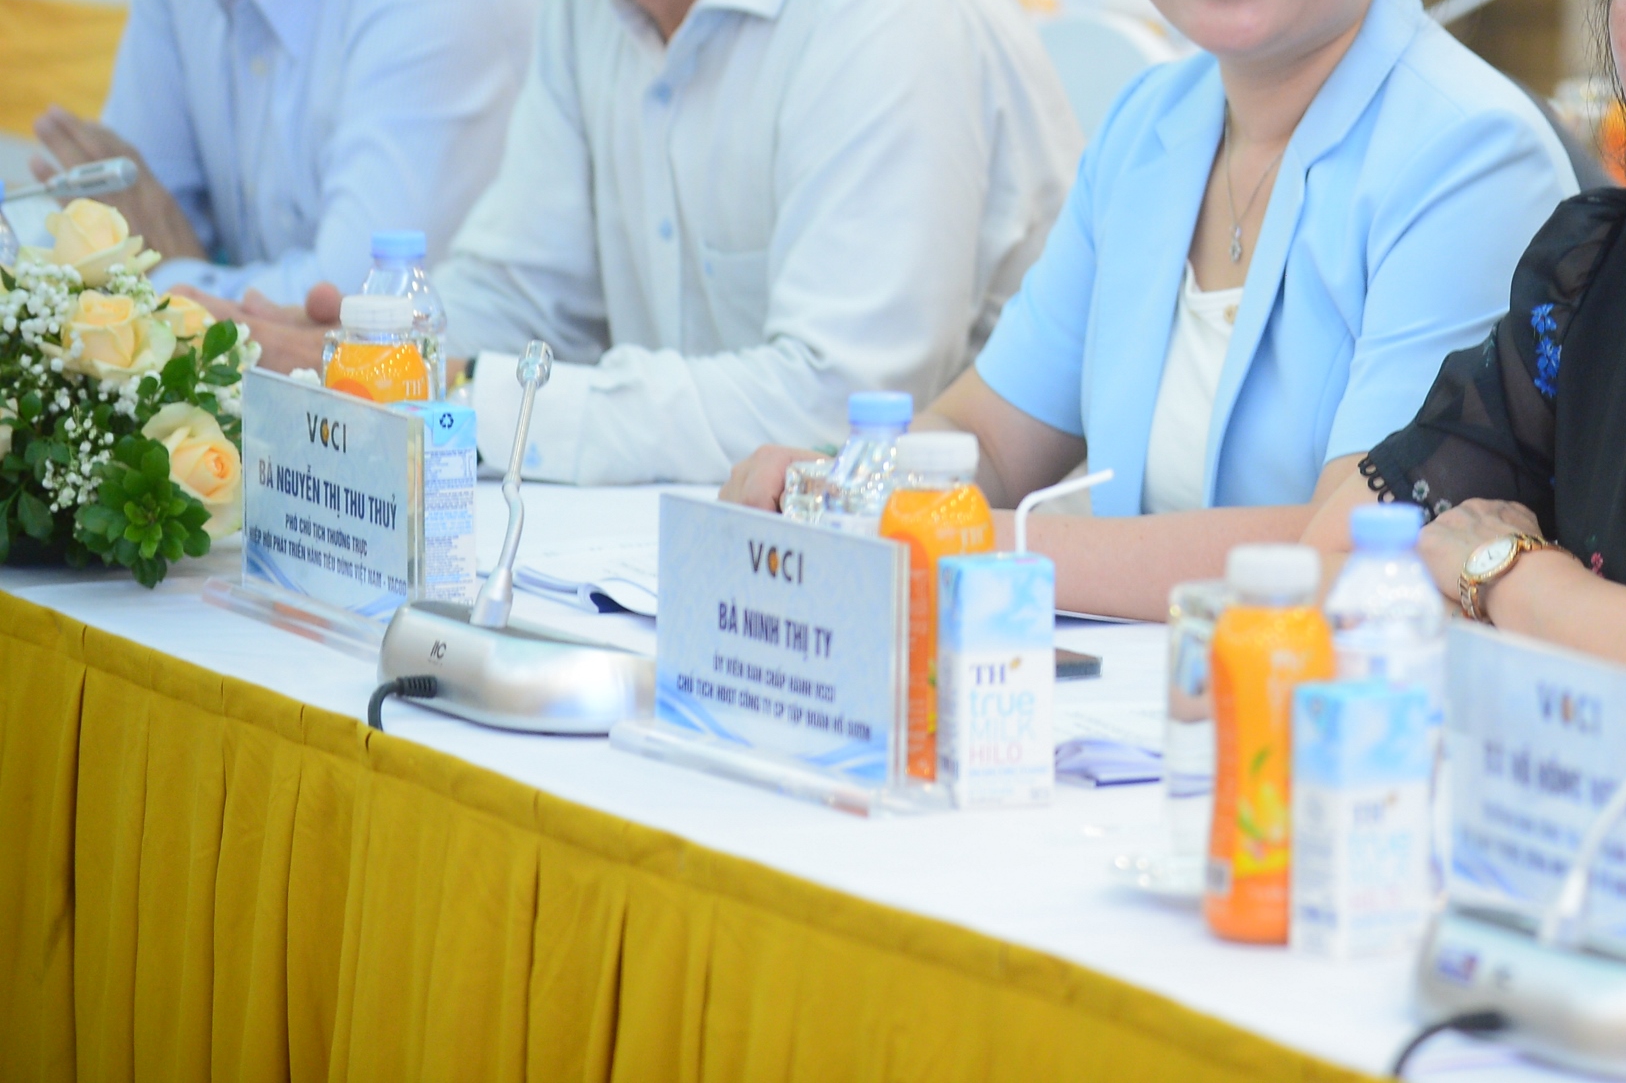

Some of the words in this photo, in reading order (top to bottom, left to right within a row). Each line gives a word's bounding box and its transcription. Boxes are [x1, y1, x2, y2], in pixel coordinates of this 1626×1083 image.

[259, 456, 274, 489] BÀ
[276, 464, 320, 505] NGUYỄN
[323, 480, 341, 518] THỊ
[344, 488, 365, 520] THU
[368, 493, 397, 531] THUỶ
[718, 598, 738, 636] BÀ
[743, 607, 780, 646] NINH
[784, 619, 809, 662] THỊ
